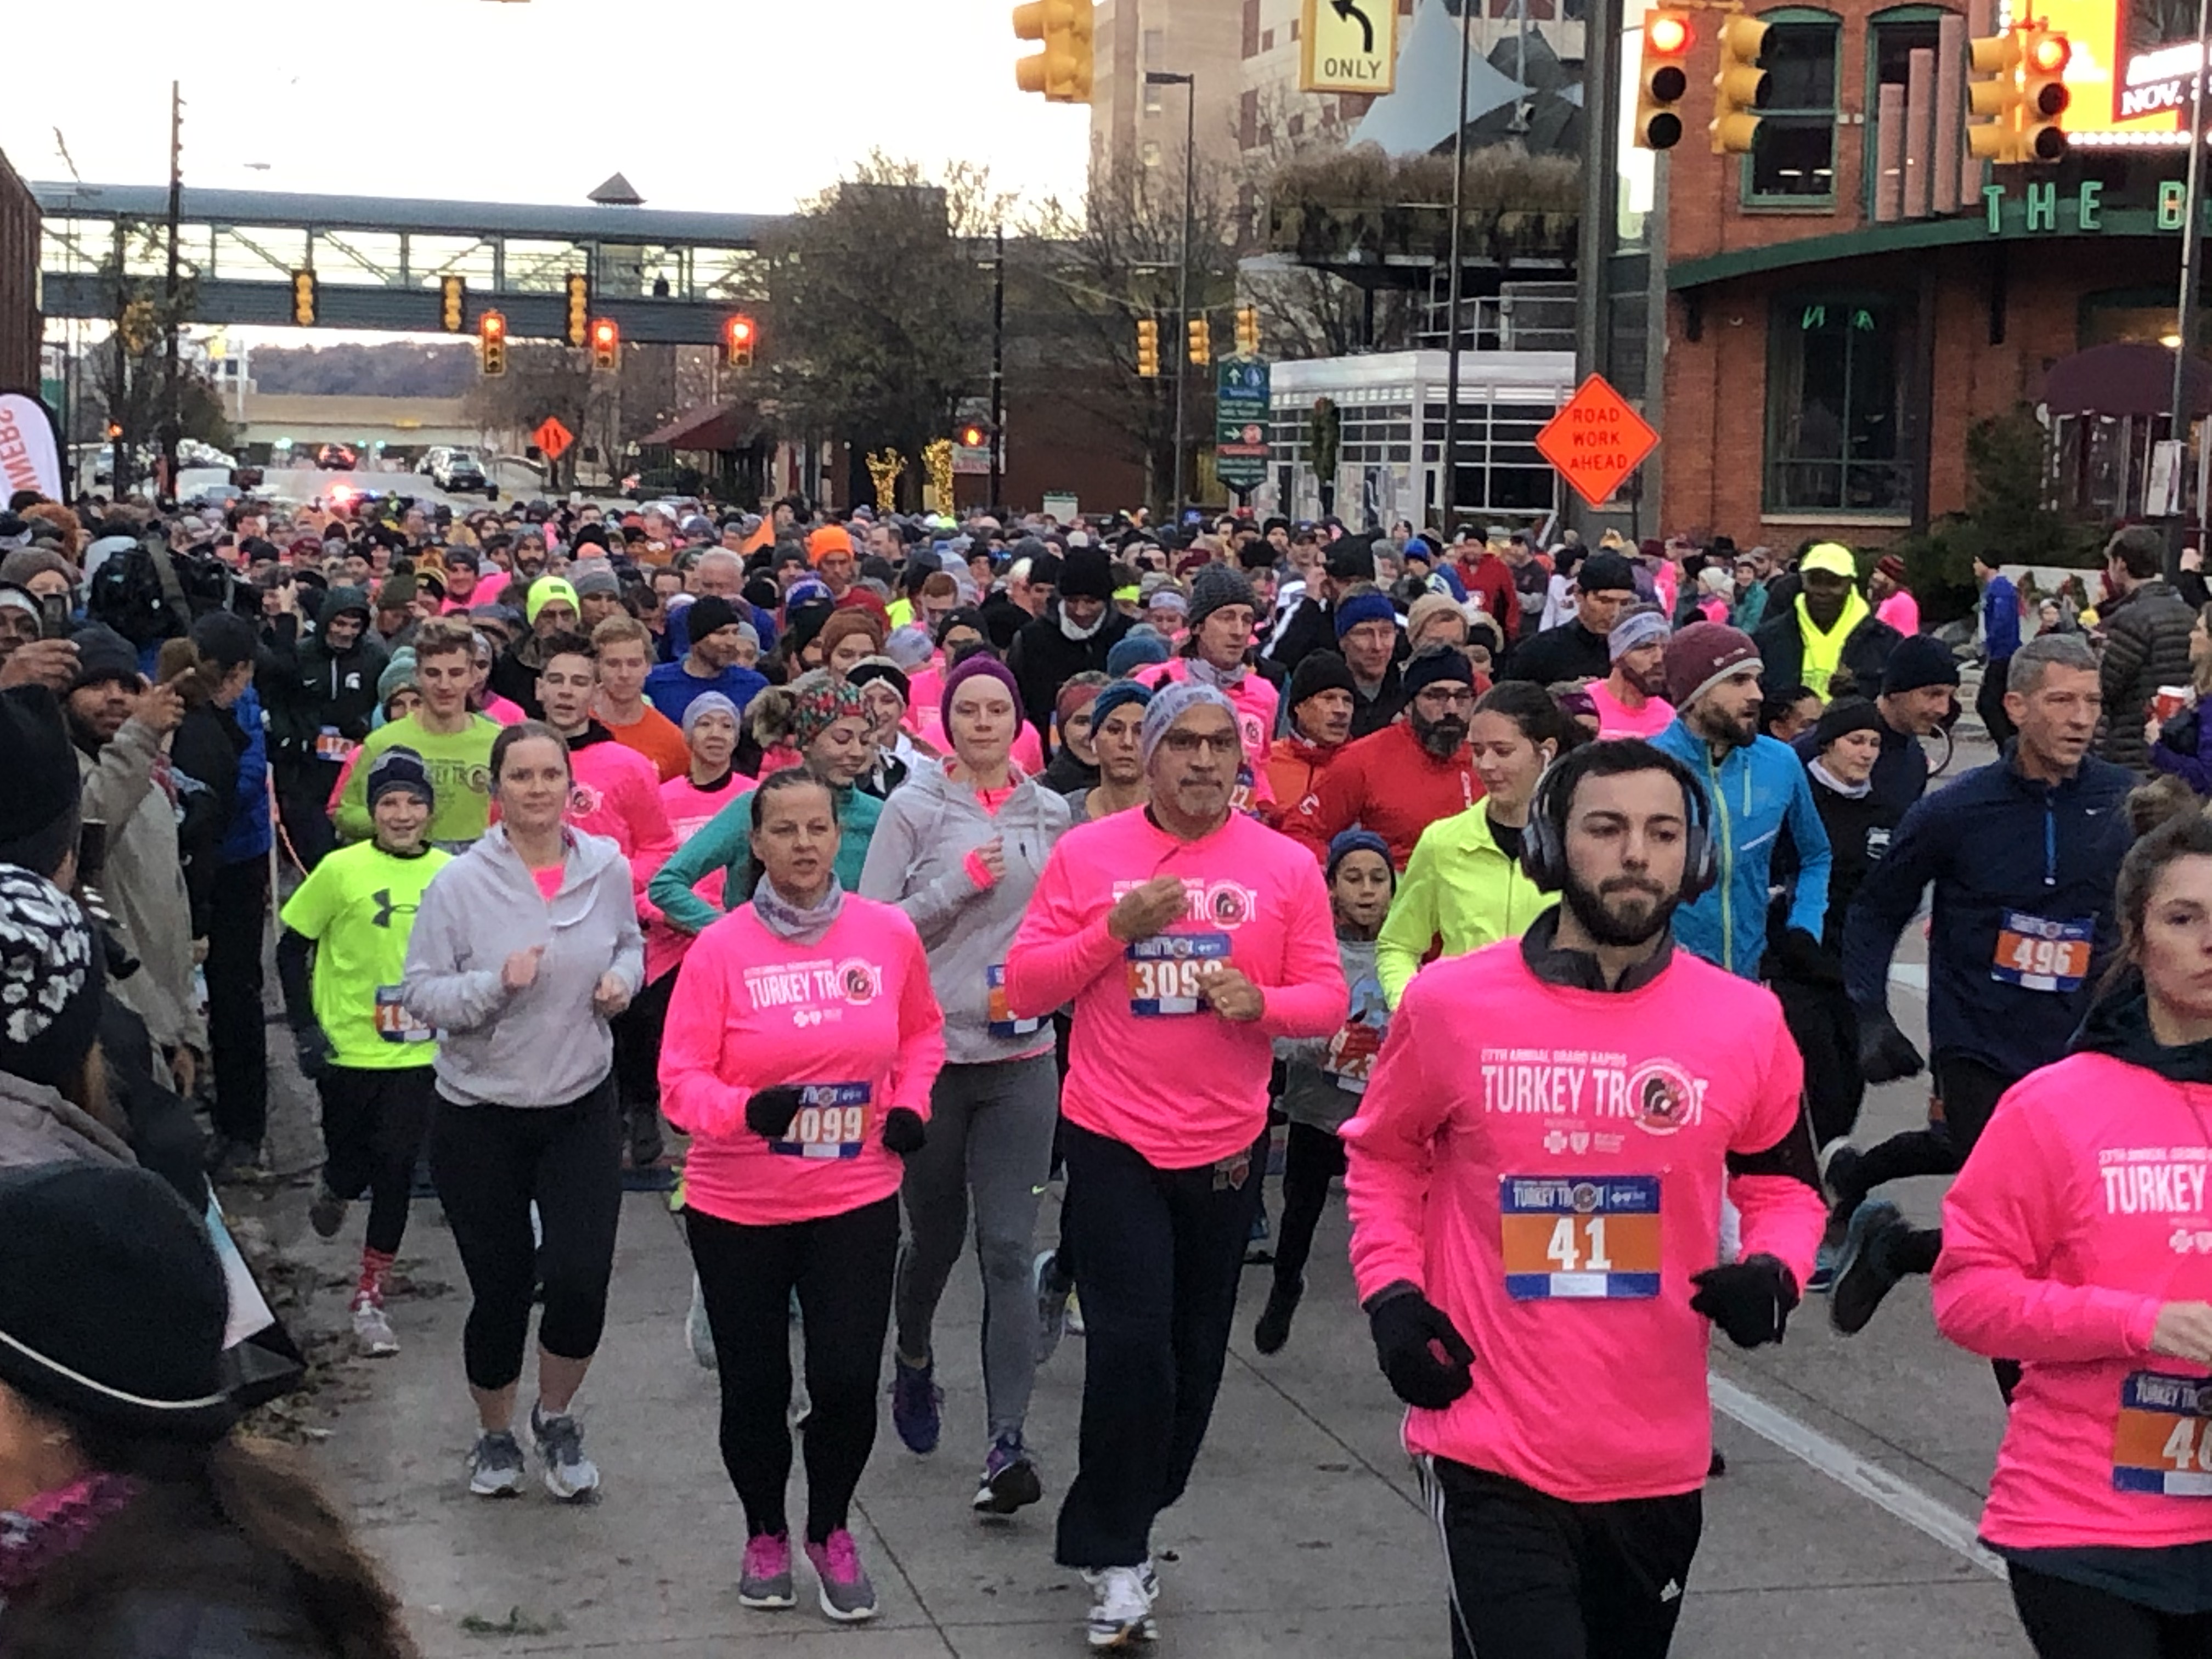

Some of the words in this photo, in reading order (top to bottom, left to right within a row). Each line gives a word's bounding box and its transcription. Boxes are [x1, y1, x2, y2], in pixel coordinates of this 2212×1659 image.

[1324, 58, 1381, 80] ONLY
[2120, 80, 2185, 116] NOV.
[1982, 181, 2104, 233] THE
[1573, 407, 1620, 423] ROAD
[1572, 431, 1621, 447] WORK
[1570, 454, 1628, 470] AHEAD
[2012, 938, 2073, 974] 496
[744, 972, 811, 1011] TURKEY
[1481, 1065, 1586, 1114] TURKEY
[2101, 1164, 2207, 1214] TURKEY
[1547, 1217, 1612, 1271] 41
